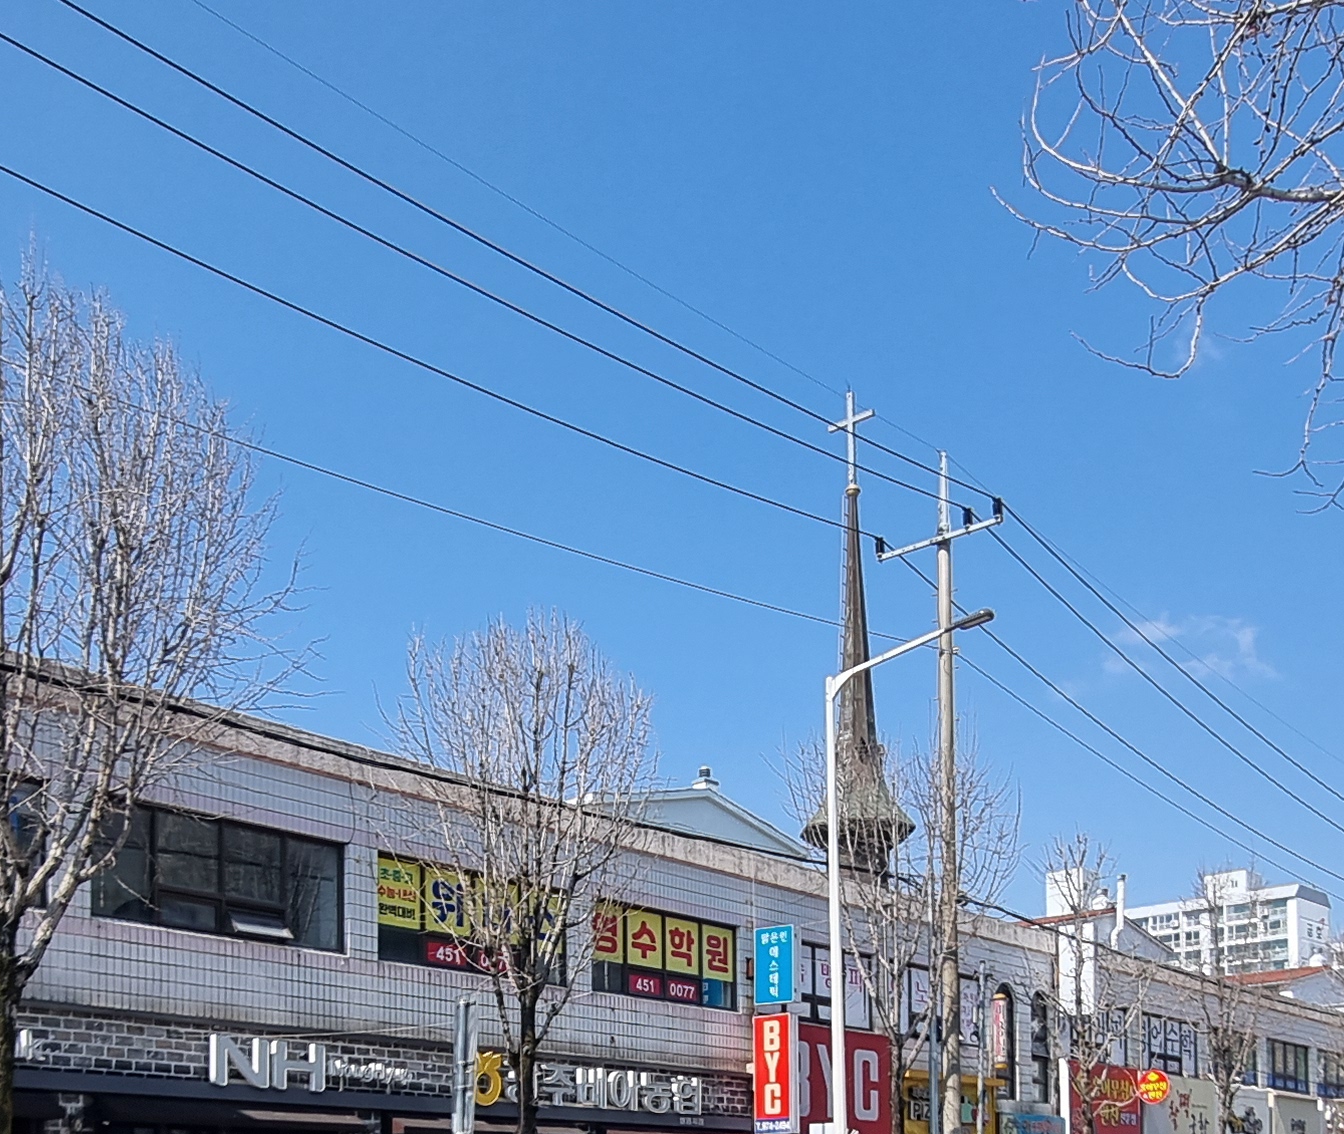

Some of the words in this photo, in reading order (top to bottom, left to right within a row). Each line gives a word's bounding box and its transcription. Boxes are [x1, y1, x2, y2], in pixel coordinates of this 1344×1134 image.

[635, 976, 655, 994] 451
[668, 983, 696, 1000] 0077
[209, 1033, 327, 1094] NH
[762, 1019, 782, 1115] BYC
